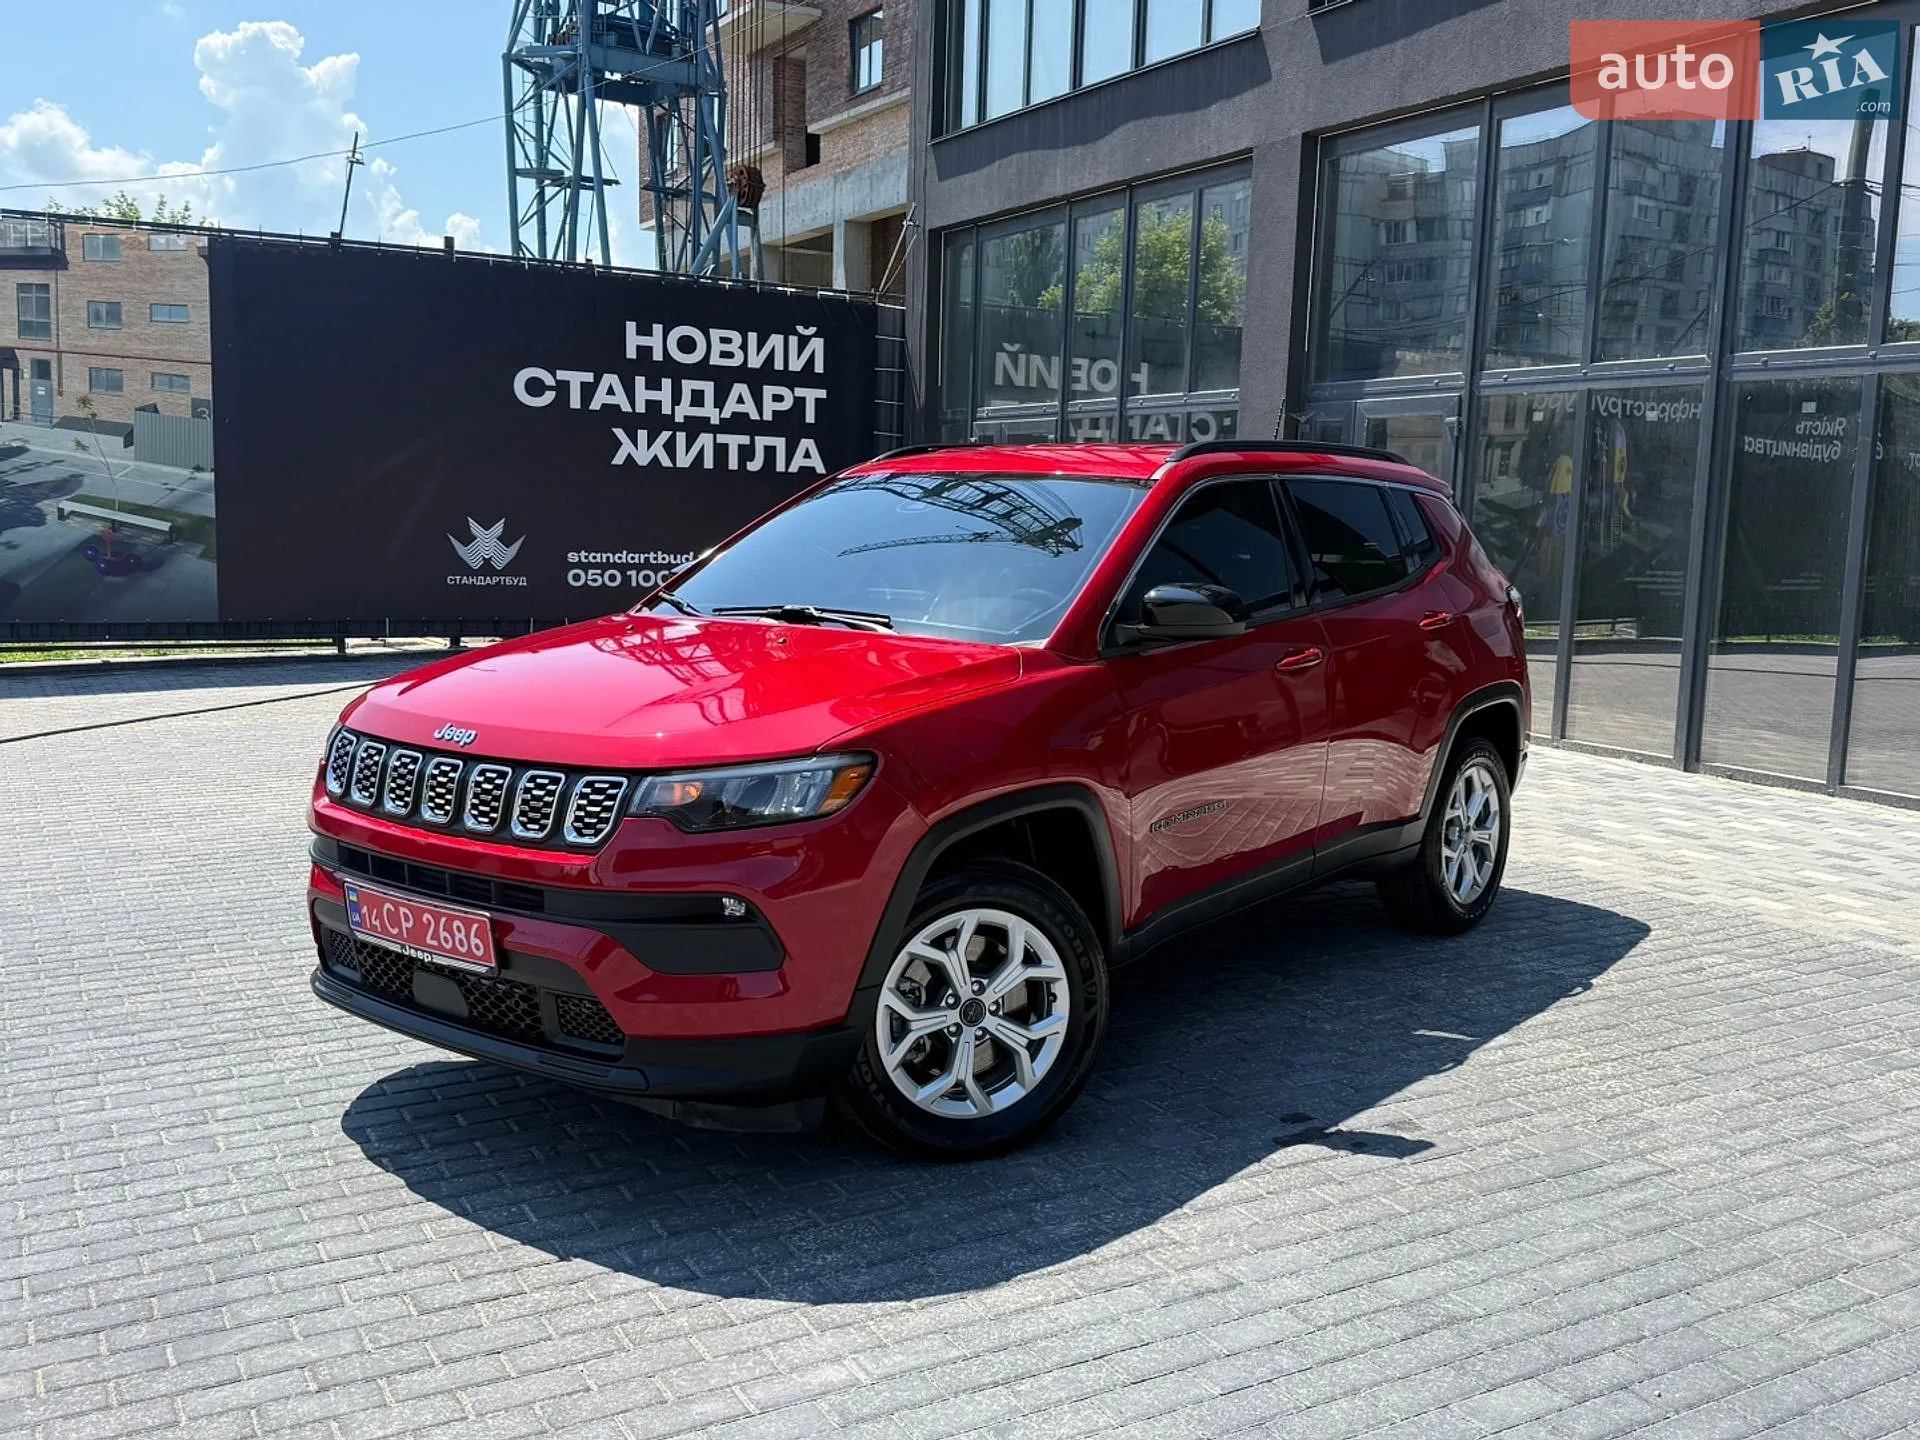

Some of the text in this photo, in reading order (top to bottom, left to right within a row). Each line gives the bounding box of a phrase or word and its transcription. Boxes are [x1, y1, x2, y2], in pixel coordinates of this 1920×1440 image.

[625, 320, 825, 374] НОВИЙ
[513, 366, 827, 425] СТАНДАРТ
[611, 427, 827, 475] ЖИТЛА
[447, 574, 527, 587] СТАНДАРТБУД
[567, 568, 622, 588] 050
[433, 722, 478, 747] Jeep
[422, 912, 485, 957] 2686
[402, 944, 433, 963] Jeep
